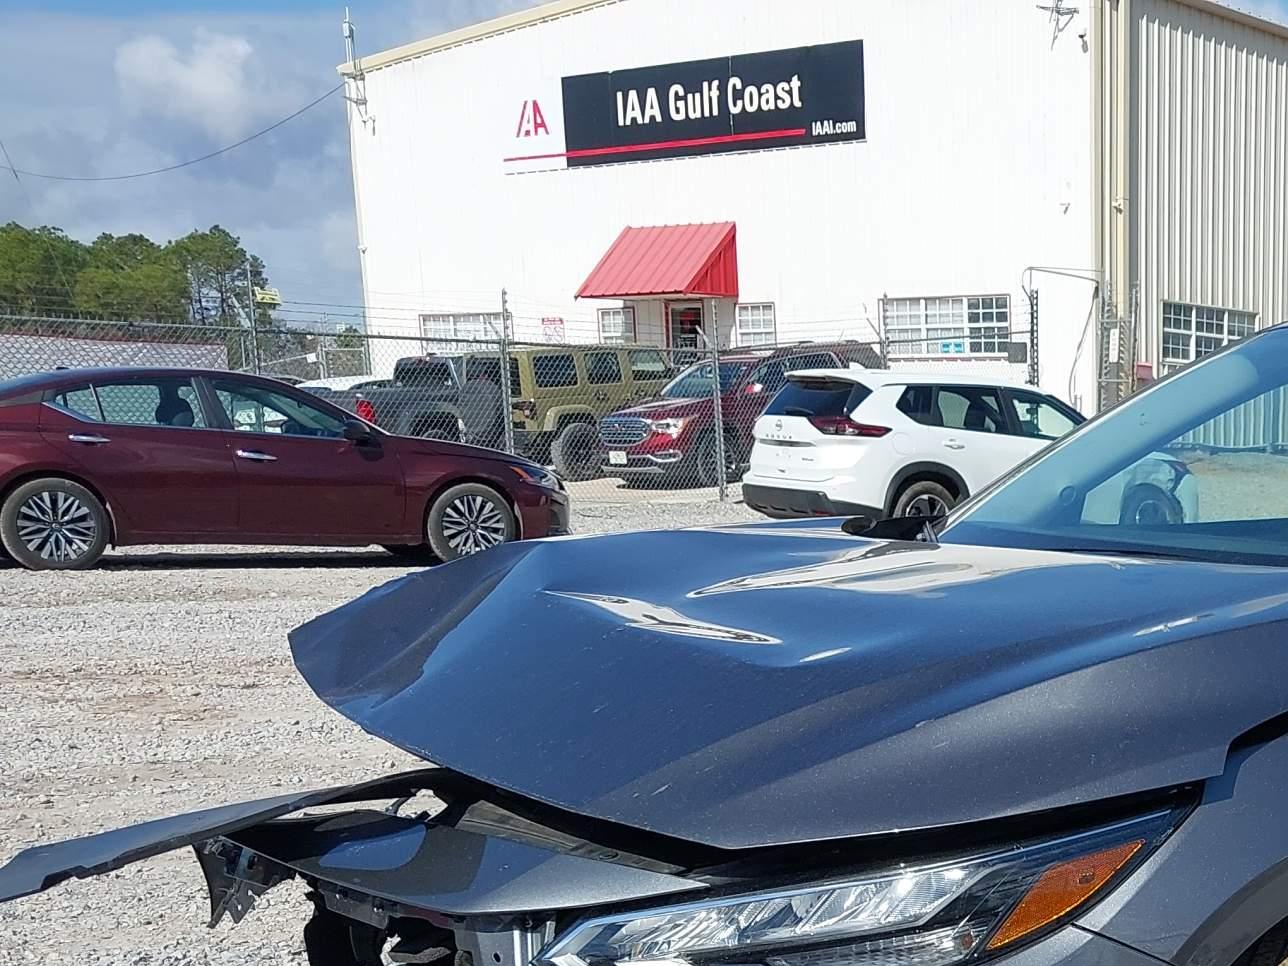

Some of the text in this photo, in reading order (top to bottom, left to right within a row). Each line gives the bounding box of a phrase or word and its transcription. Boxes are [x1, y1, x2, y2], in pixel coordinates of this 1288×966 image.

[616, 73, 802, 126] IAA Gulf Coast
[811, 118, 857, 136] IAAI.com
